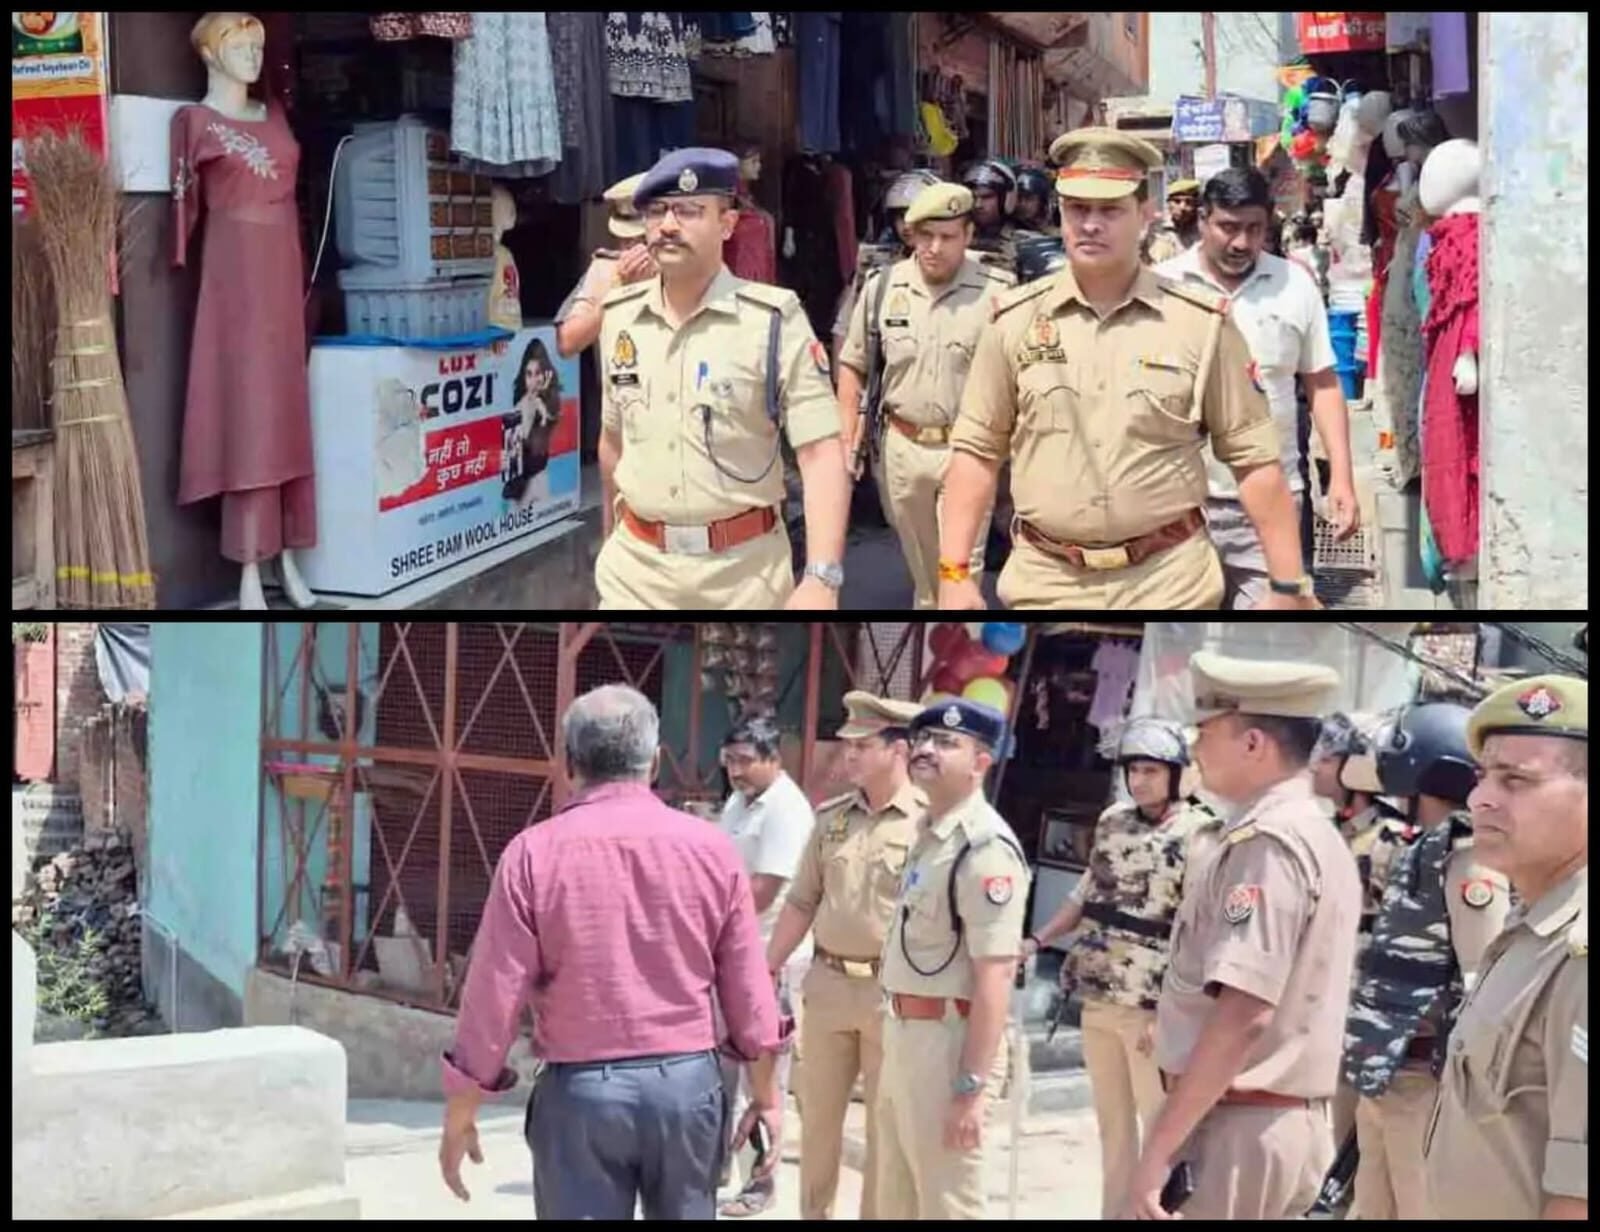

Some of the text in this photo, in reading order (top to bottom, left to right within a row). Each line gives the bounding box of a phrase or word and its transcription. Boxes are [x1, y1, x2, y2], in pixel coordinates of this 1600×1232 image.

[439, 354, 476, 375] LUX
[420, 373, 493, 418] COZI
[429, 434, 470, 465] नहीं तो
[437, 450, 487, 490] कुछ नहीं
[391, 544, 434, 577] SHREE
[436, 532, 461, 560] RAM
[465, 521, 497, 549] WOOL
[500, 502, 534, 533] HOUSE
